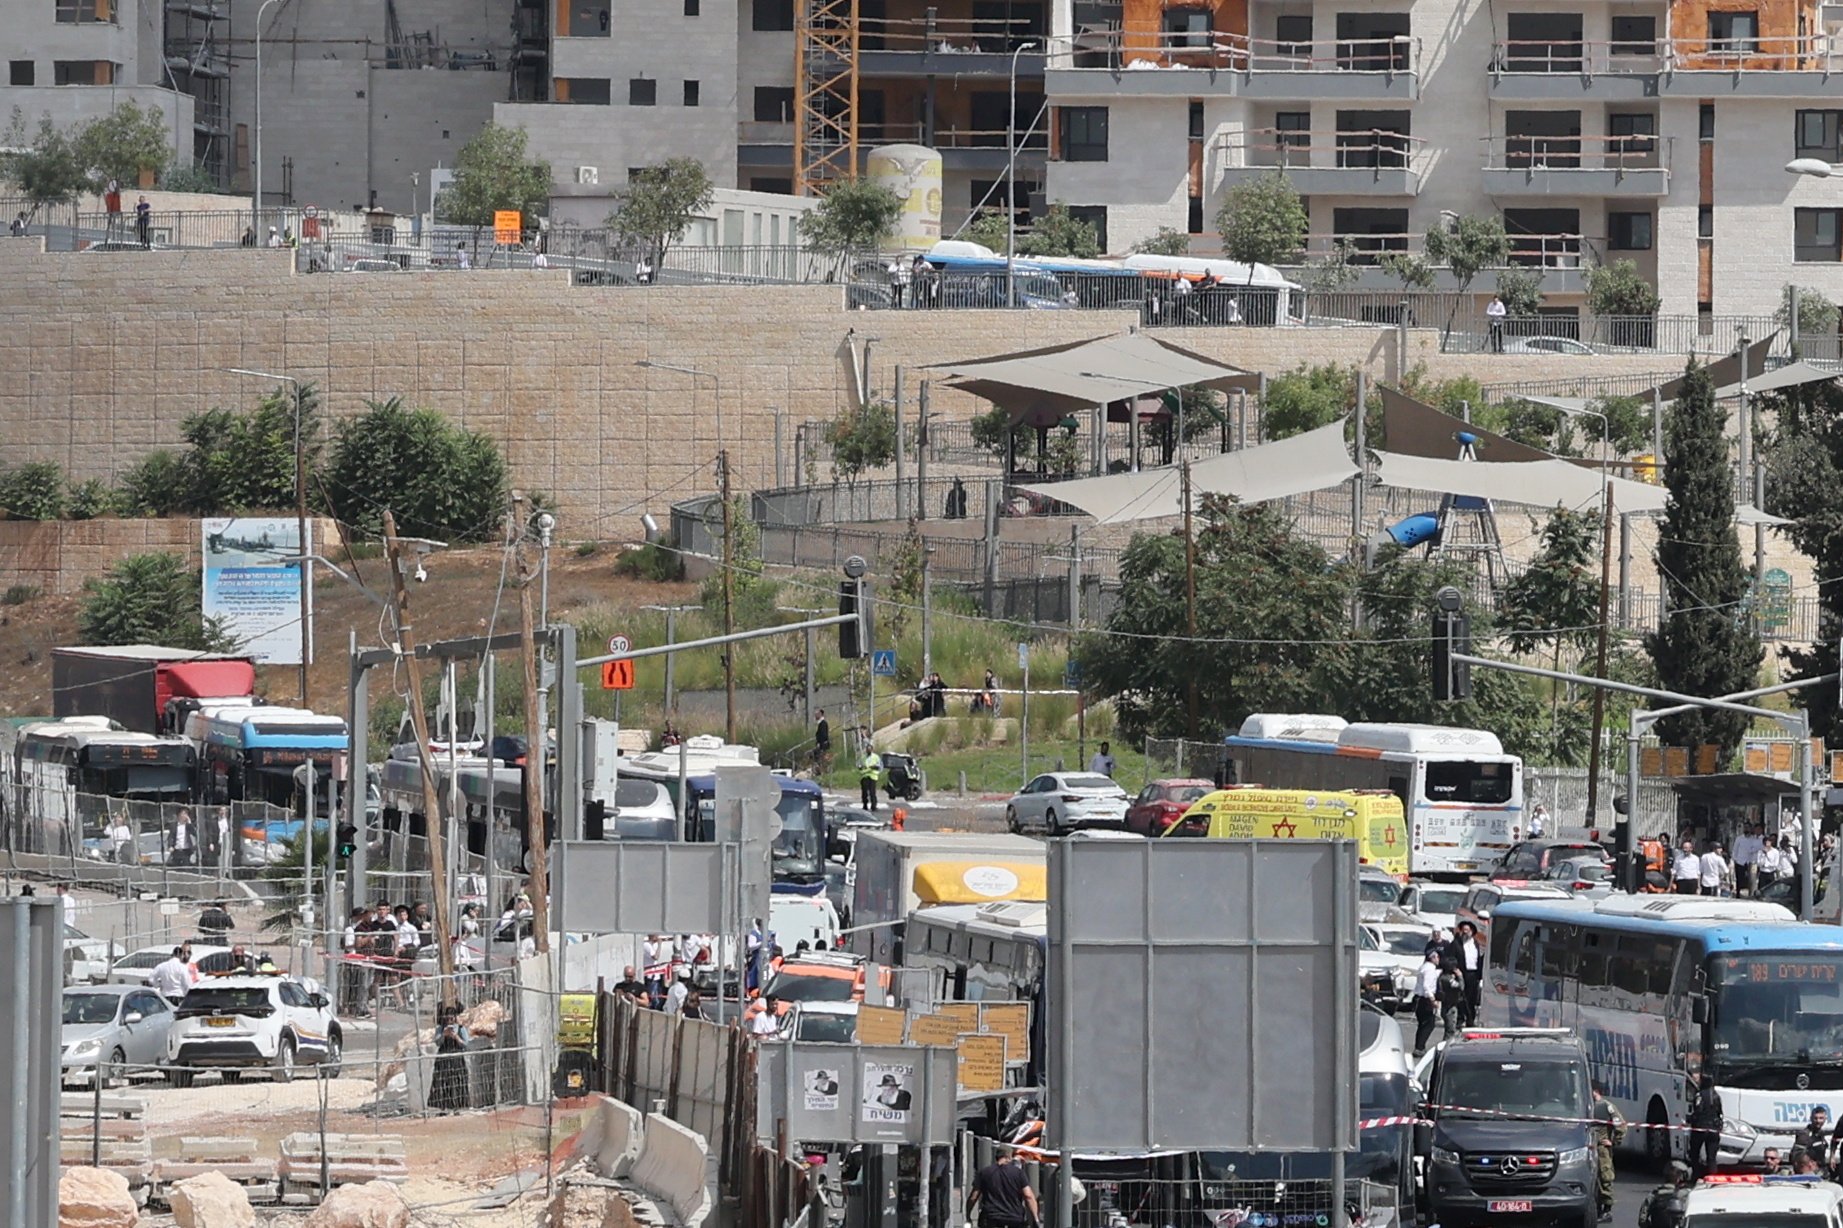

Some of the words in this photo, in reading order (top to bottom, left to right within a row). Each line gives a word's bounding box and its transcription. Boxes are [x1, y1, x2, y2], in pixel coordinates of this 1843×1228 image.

[612, 640, 627, 651] 50
[1229, 815, 1259, 824] MAGEN
[1229, 824, 1253, 832] DAVID
[870, 1110, 902, 1119] משיח
